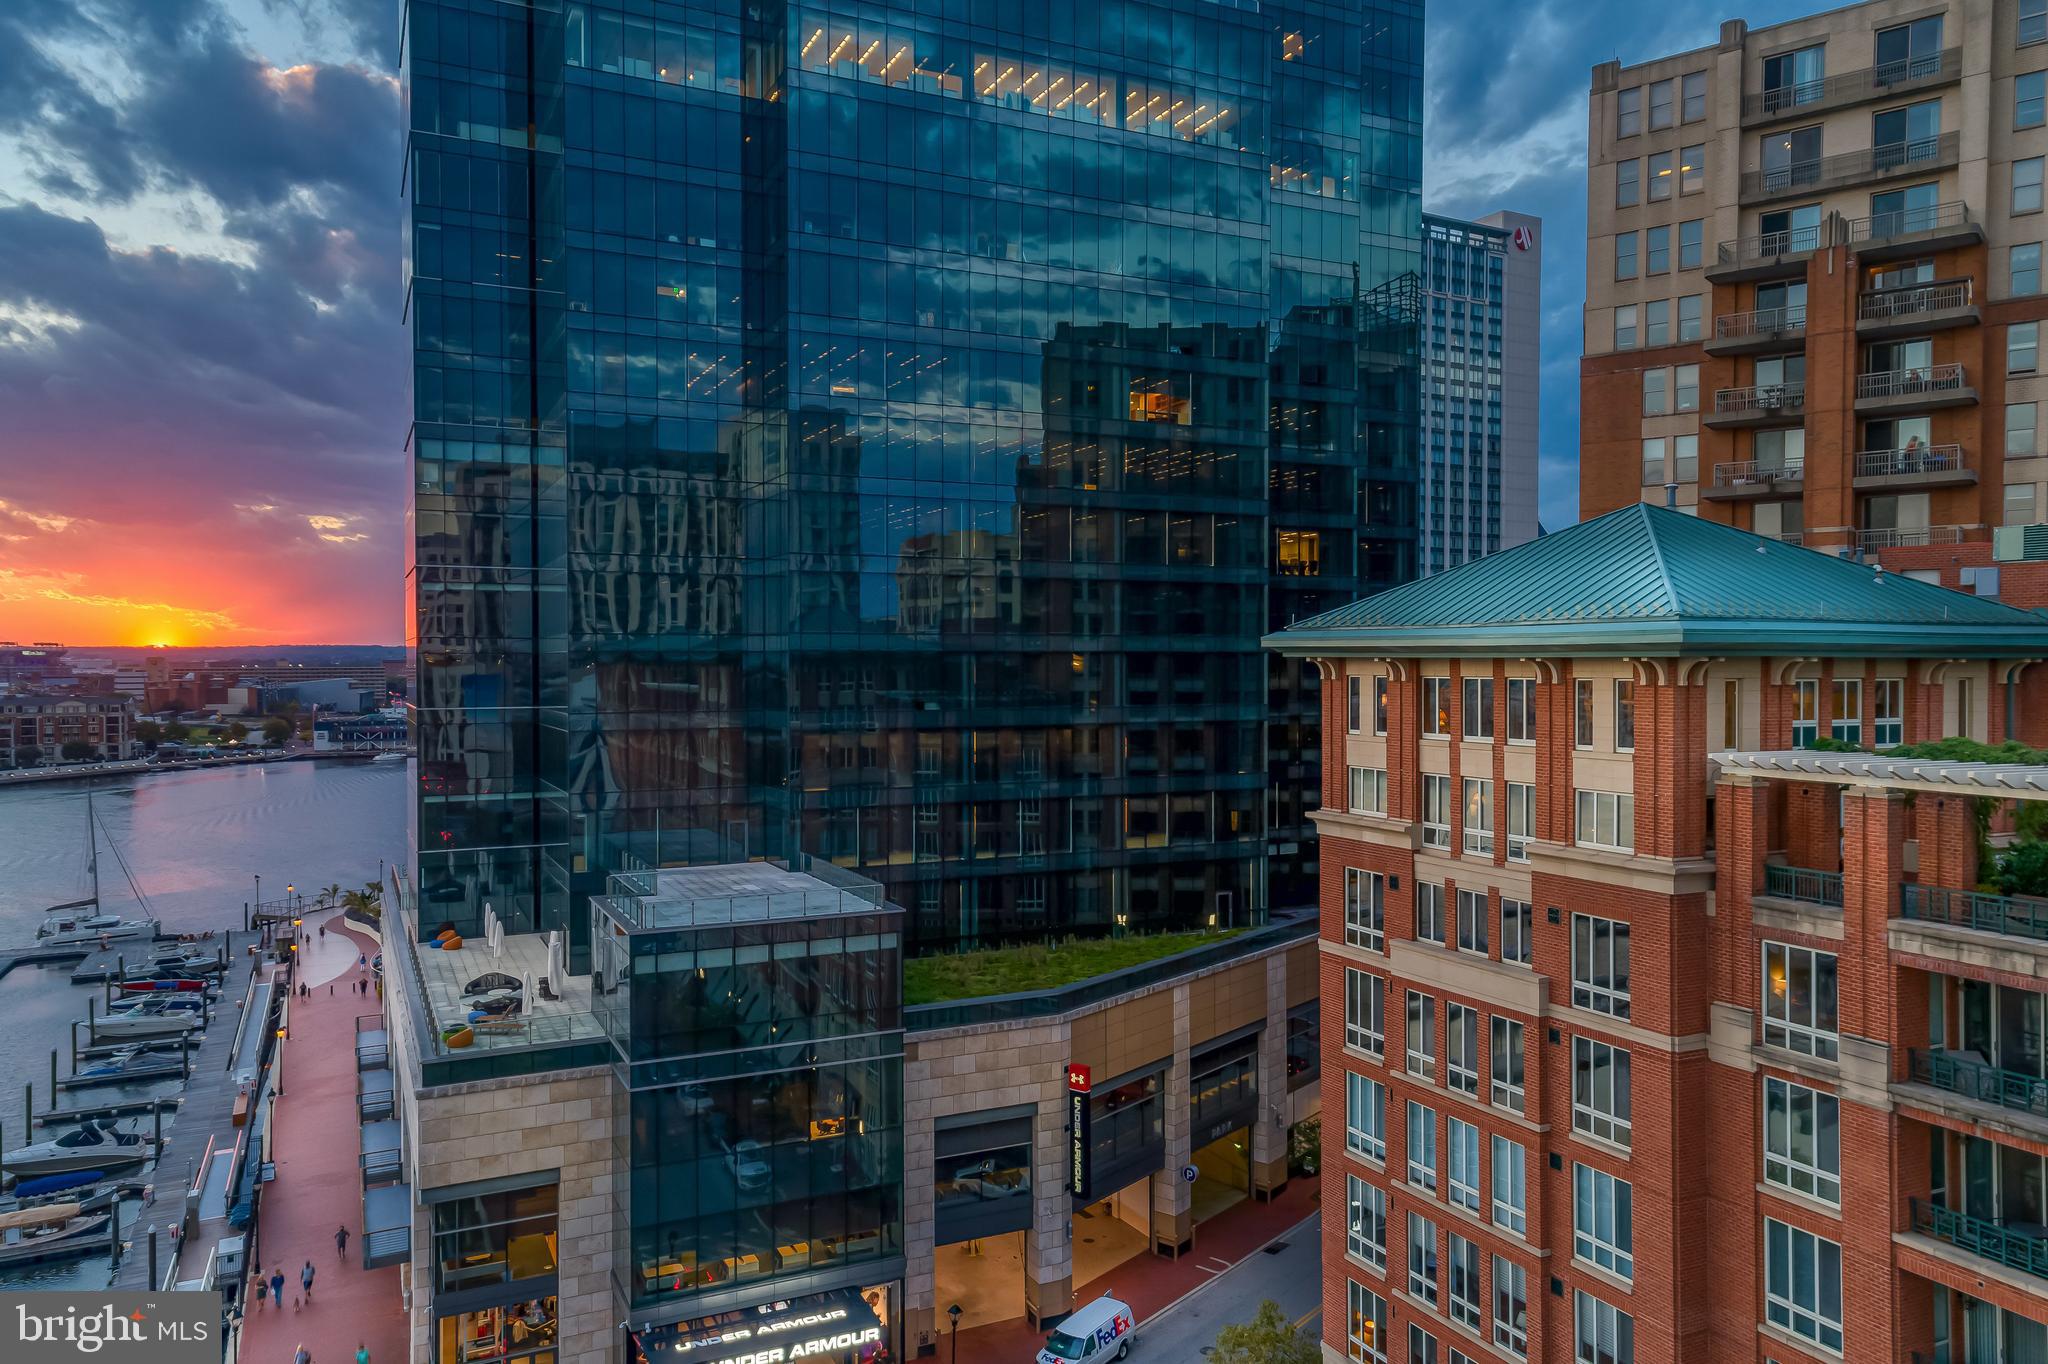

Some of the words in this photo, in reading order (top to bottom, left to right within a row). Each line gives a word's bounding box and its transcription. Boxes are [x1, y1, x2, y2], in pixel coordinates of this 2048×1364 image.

[1074, 1096, 1082, 1138] UNDER
[1074, 1139, 1082, 1193] ARMOUR
[674, 1329, 752, 1351] UNDER
[757, 1309, 847, 1335] ARMOUR
[710, 1348, 784, 1364] NDER
[789, 1327, 880, 1360] ARMOUR
[1096, 1314, 1131, 1350] FedEx
